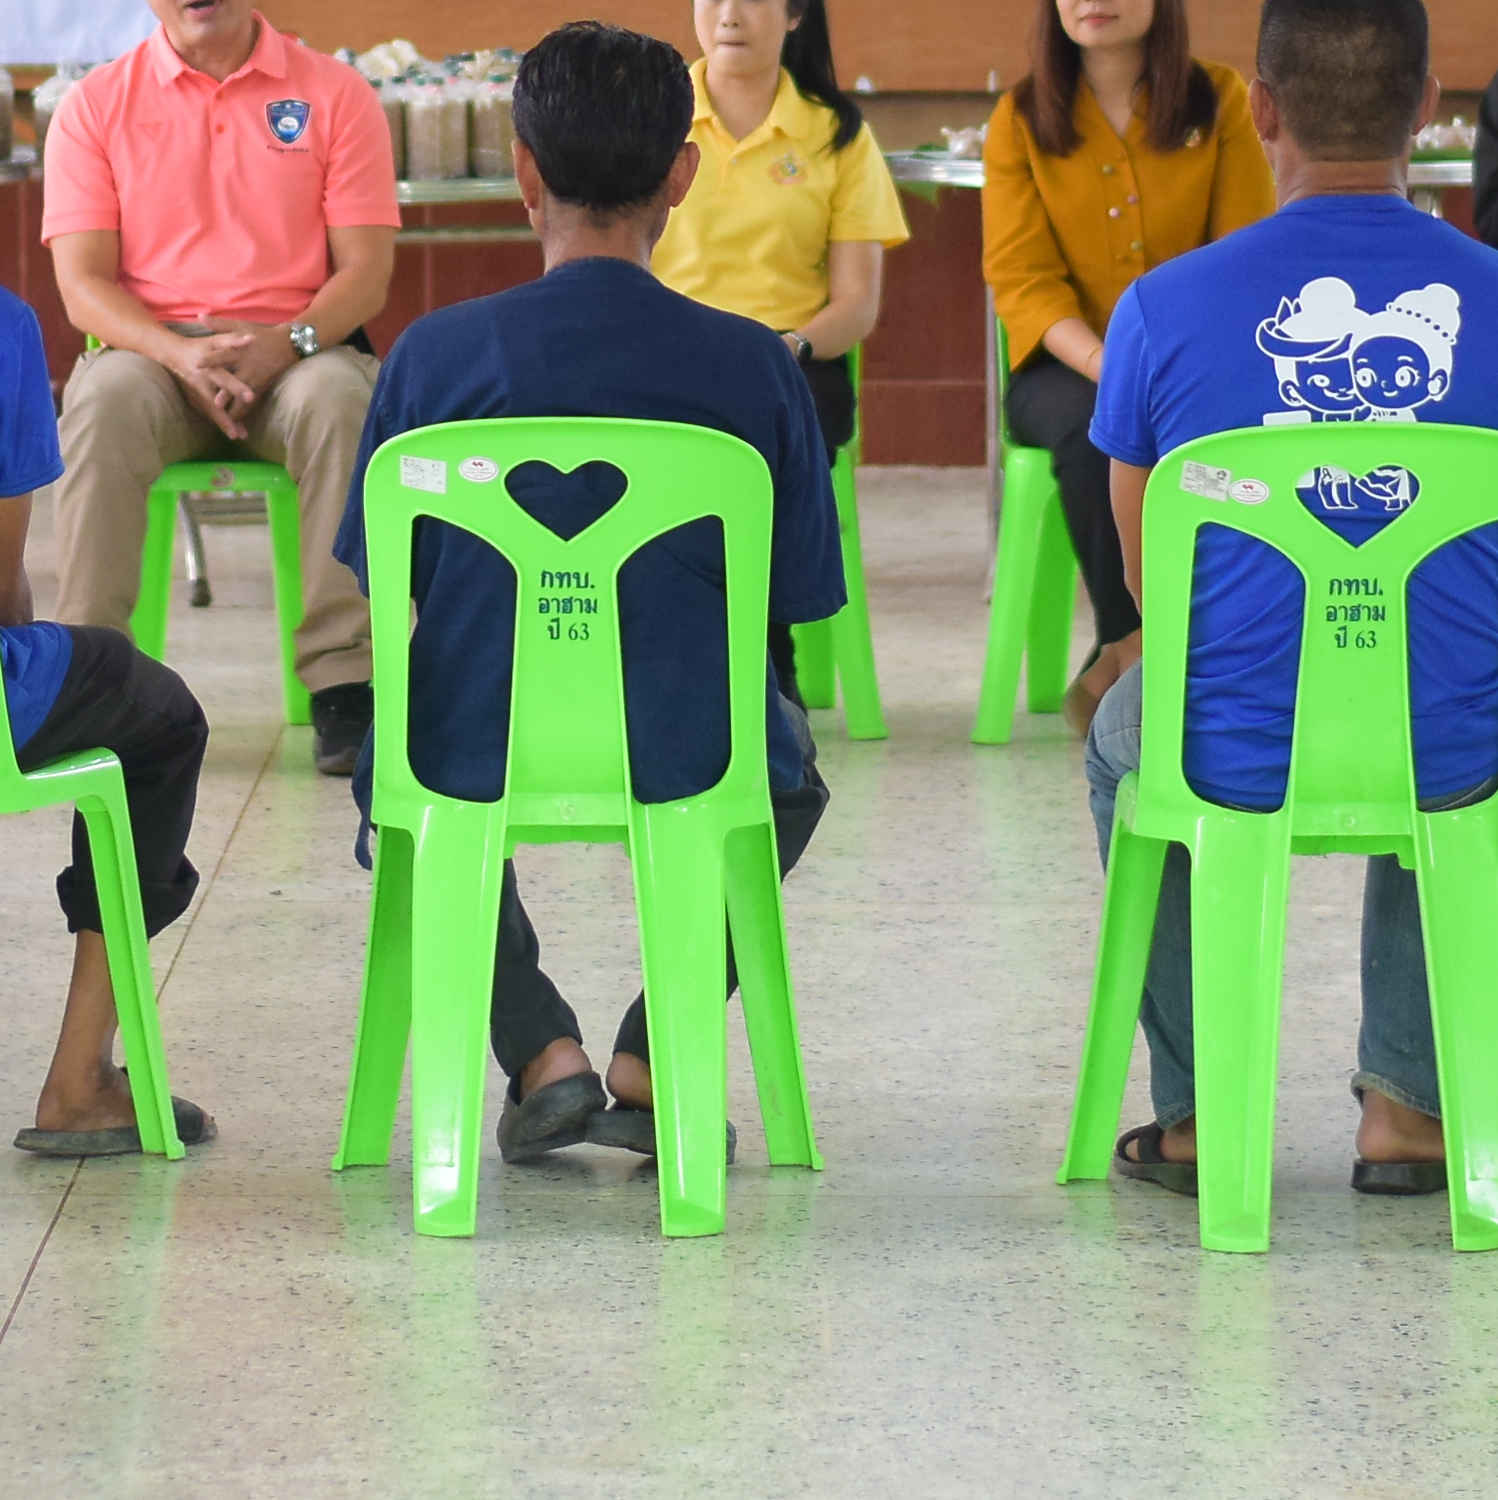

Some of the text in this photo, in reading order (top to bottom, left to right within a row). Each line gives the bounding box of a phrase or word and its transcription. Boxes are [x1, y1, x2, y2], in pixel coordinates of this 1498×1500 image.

[540, 569, 595, 589] กทบ.
[1328, 577, 1384, 597] กทบ.
[538, 596, 598, 614] อาฮาม
[1325, 603, 1386, 622] อาฮาม
[547, 617, 590, 641] ปี 63
[1334, 626, 1377, 649] ปี 63
